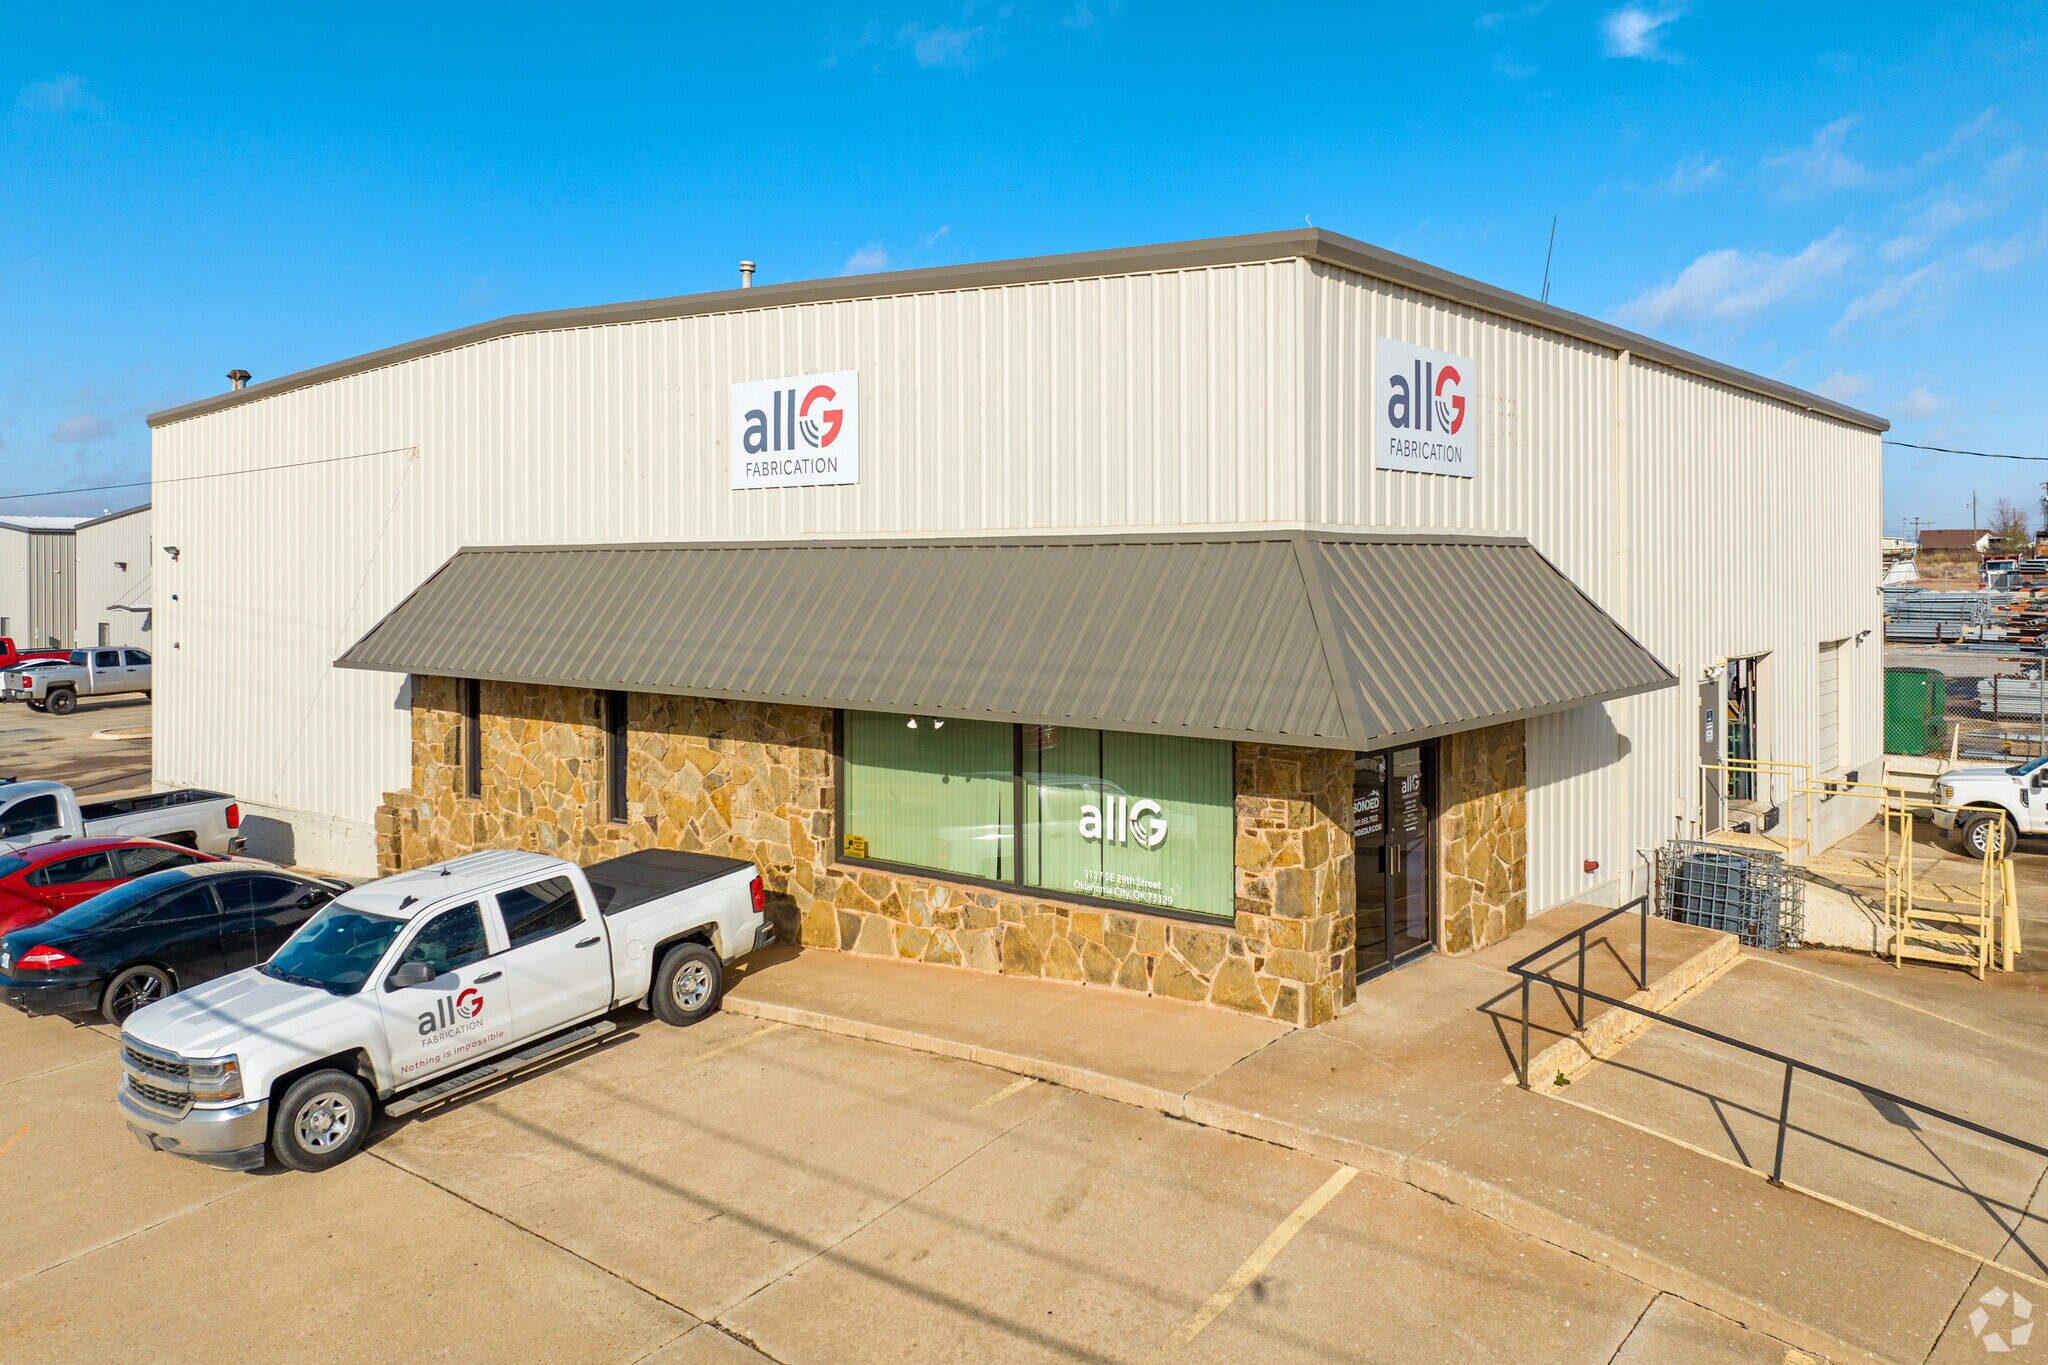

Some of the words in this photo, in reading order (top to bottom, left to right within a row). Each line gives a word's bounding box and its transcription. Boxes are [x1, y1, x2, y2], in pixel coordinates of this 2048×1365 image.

[1387, 358, 1466, 436] allG
[743, 384, 843, 455] allG
[746, 457, 838, 477] FABRICATION
[1390, 437, 1462, 463] FABRICATION
[1079, 794, 1168, 846] allG
[1073, 880, 1113, 895] Oklahoma
[1114, 887, 1131, 900] City,
[1133, 890, 1146, 900] OK
[1147, 892, 1173, 905] 73129
[1084, 869, 1103, 879] 1117
[1105, 872, 1115, 881] SE
[1116, 874, 1135, 885] 29th
[1136, 876, 1162, 890] Street
[417, 987, 484, 1036] allG
[421, 1019, 484, 1048] FABRICATION
[400, 1055, 441, 1074] Nothing
[443, 1049, 452, 1059] is
[453, 1030, 508, 1055] impossible.
